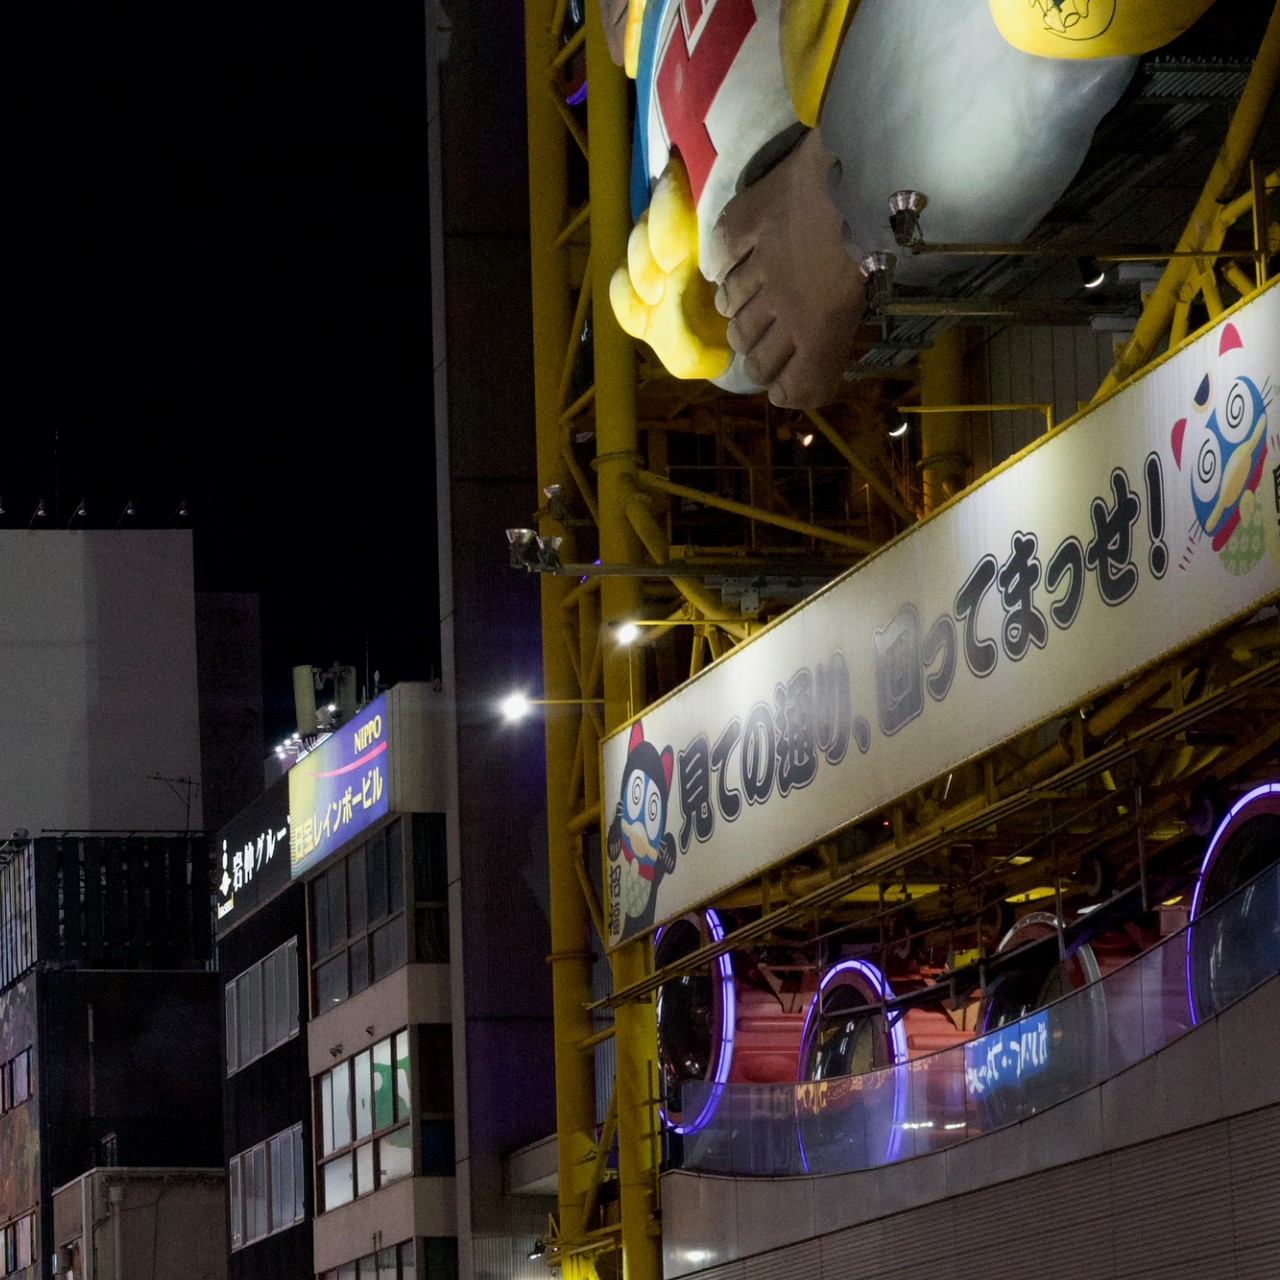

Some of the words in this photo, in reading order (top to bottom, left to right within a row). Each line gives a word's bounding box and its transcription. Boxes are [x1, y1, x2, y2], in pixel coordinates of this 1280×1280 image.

[354, 714, 382, 755] NIPPO
[294, 766, 384, 862] 日宝レインボービル
